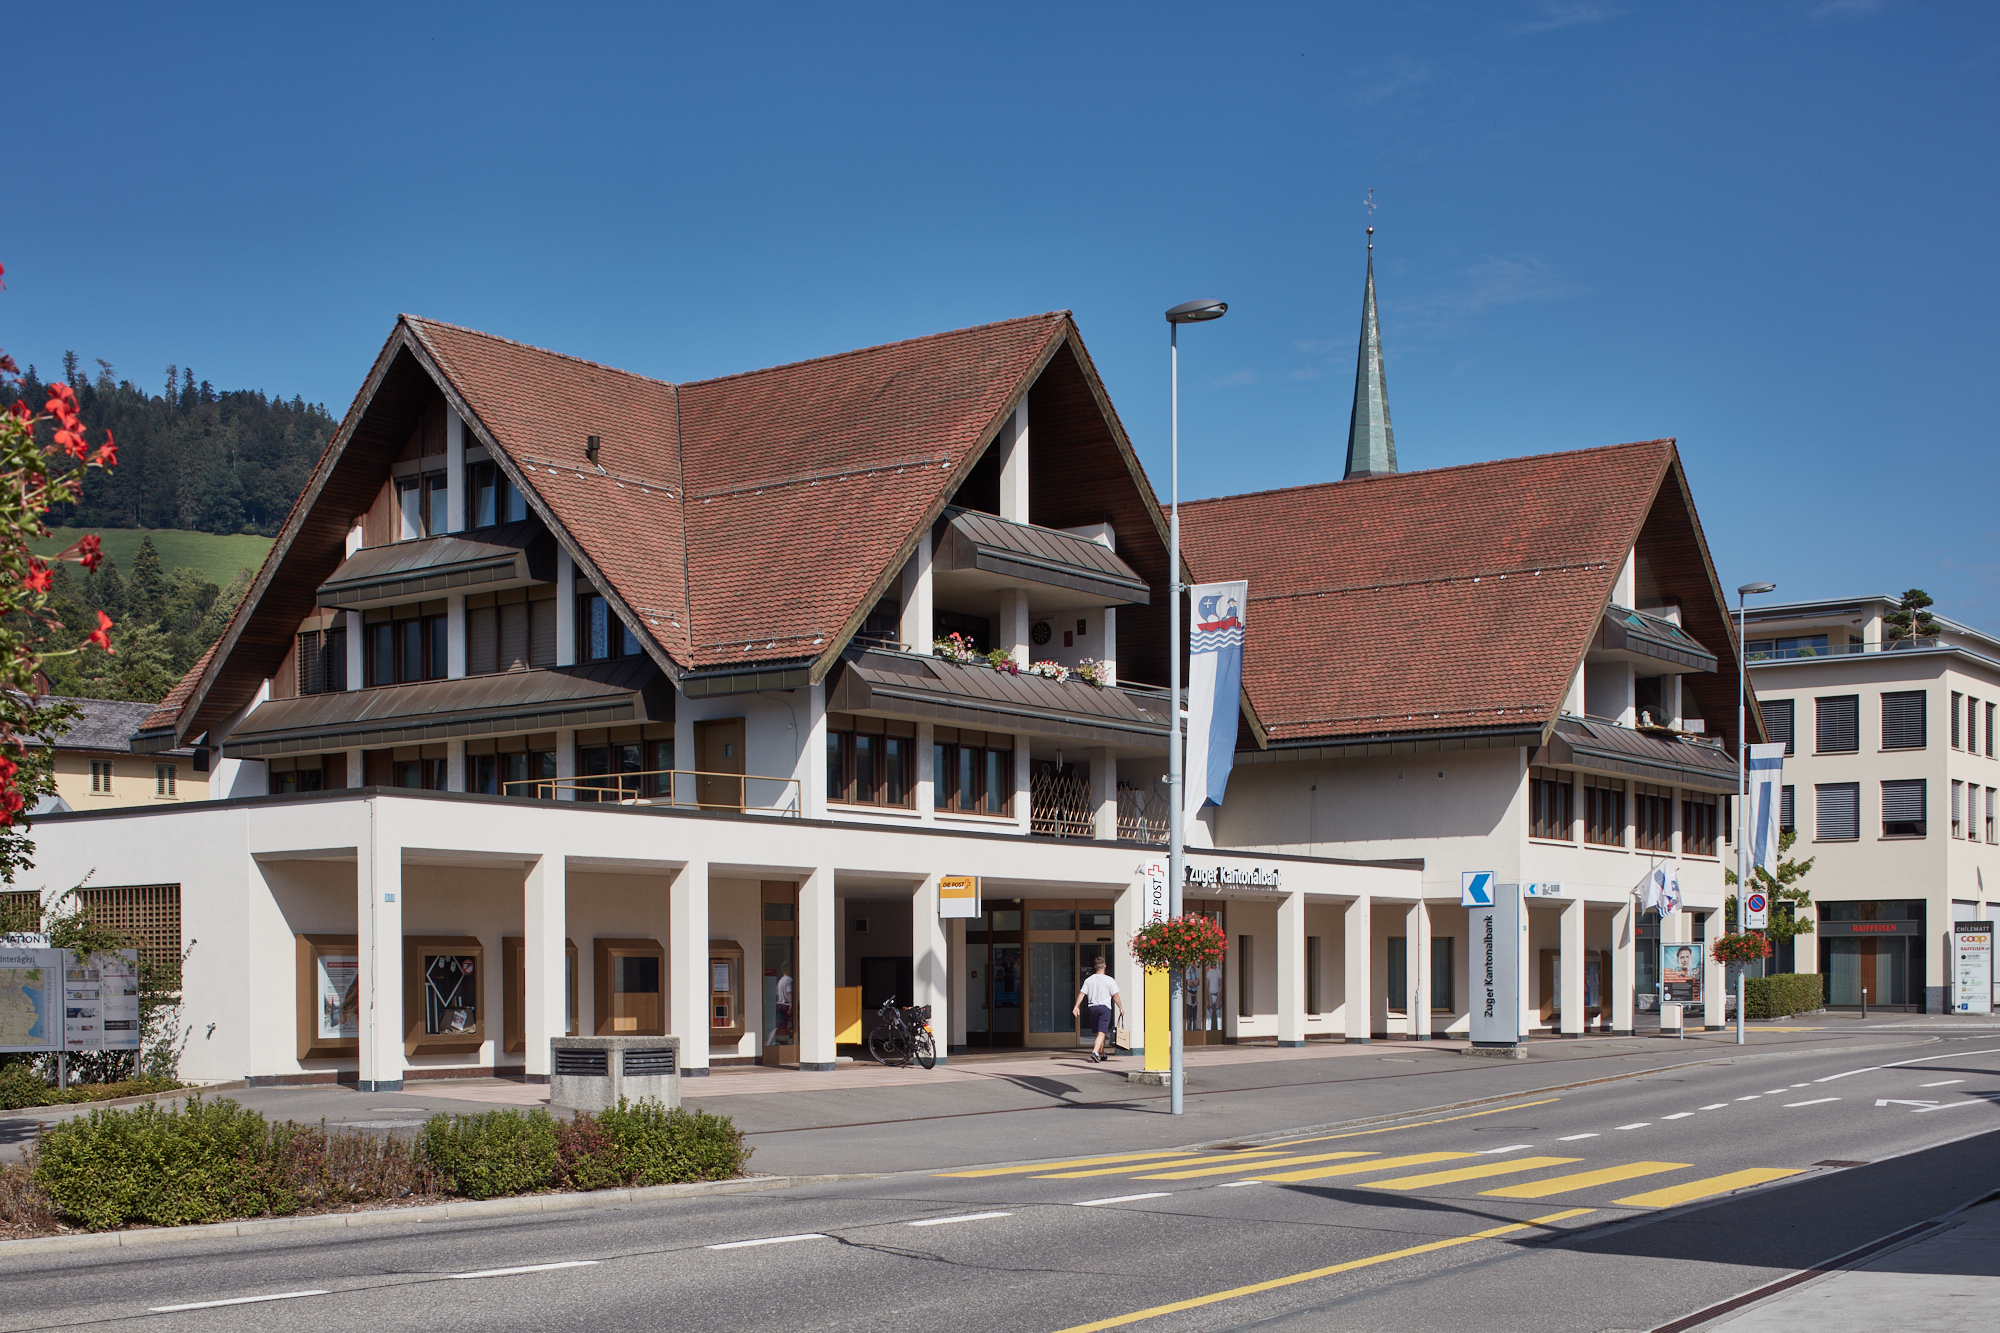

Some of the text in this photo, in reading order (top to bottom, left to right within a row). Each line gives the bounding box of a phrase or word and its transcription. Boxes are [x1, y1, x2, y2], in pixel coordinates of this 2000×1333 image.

[1189, 866, 1283, 888] Zuger Kantonalbank
[1153, 877, 1162, 906] POST
[1852, 924, 1897, 932] RAIFFEISEN
[1960, 935, 1988, 944] coop
[1483, 914, 1496, 1018] Zuger Kantonalbank
